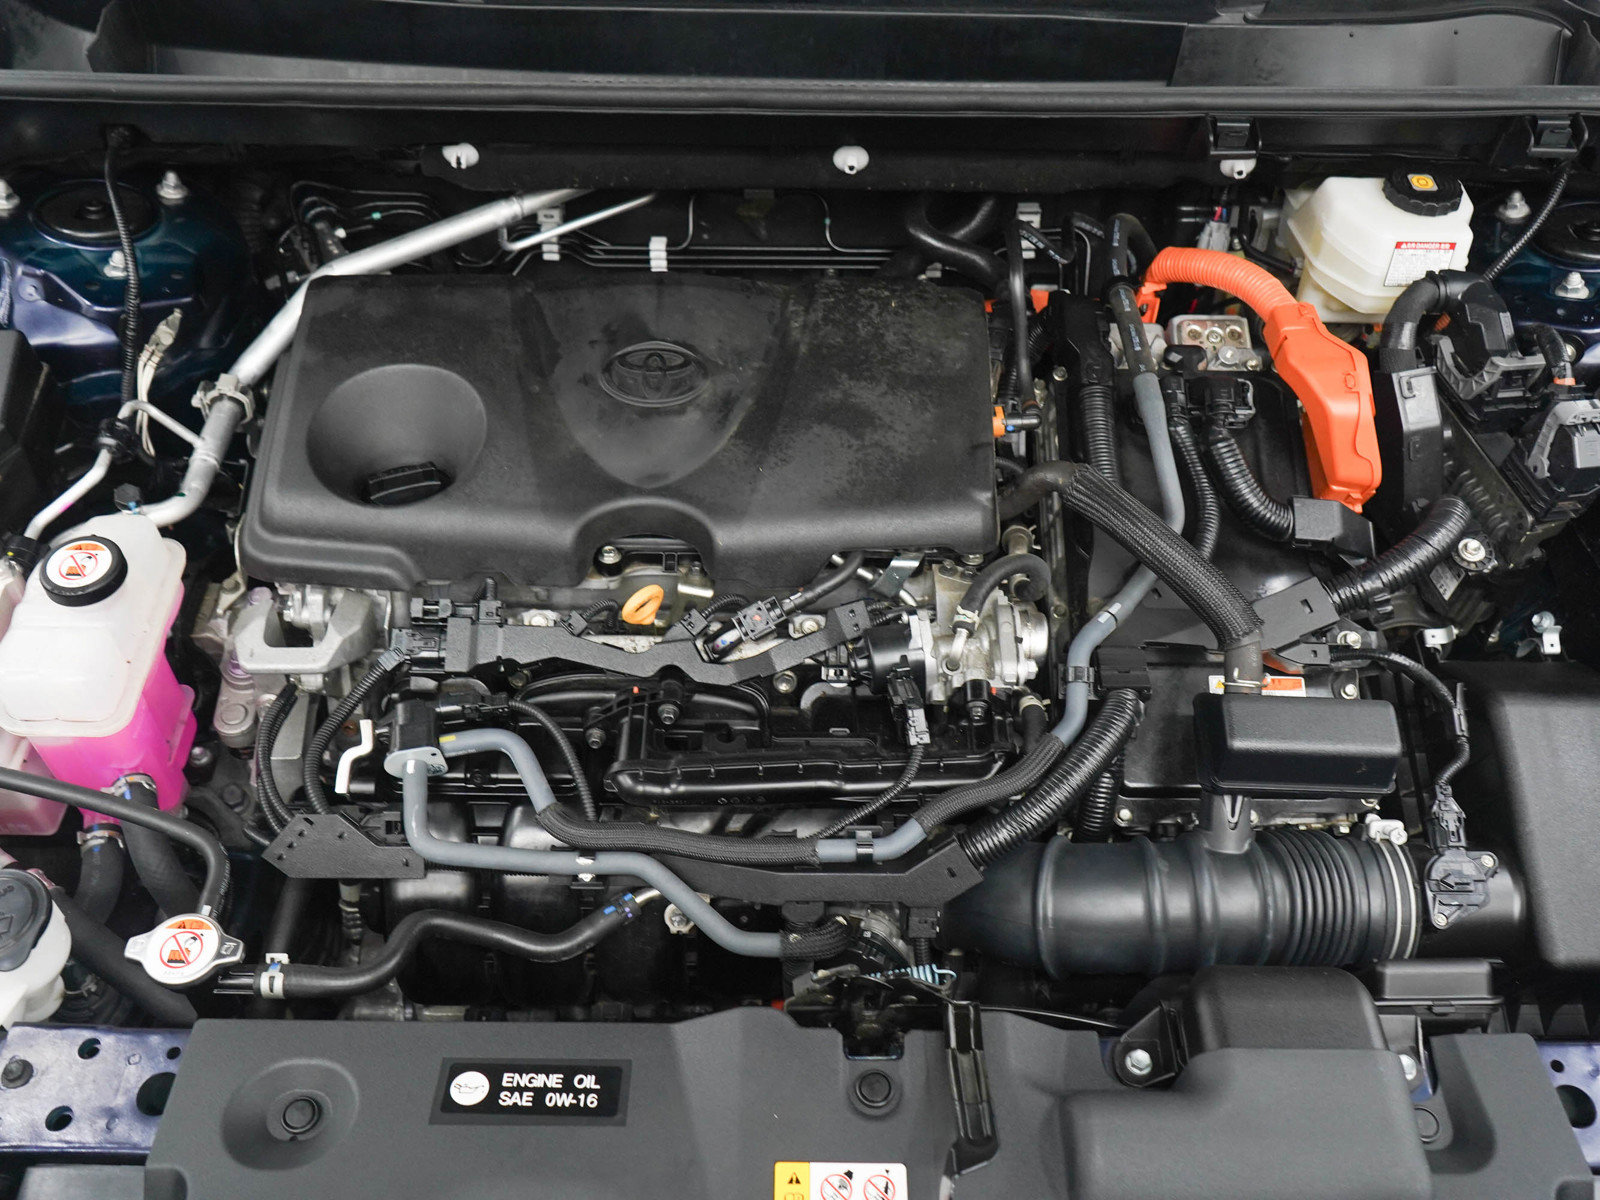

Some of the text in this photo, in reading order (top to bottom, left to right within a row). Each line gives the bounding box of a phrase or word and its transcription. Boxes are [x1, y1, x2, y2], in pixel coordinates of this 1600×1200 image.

[501, 1072, 600, 1089] ENGINE OIL
[498, 1091, 599, 1108] SAE 0W-16
